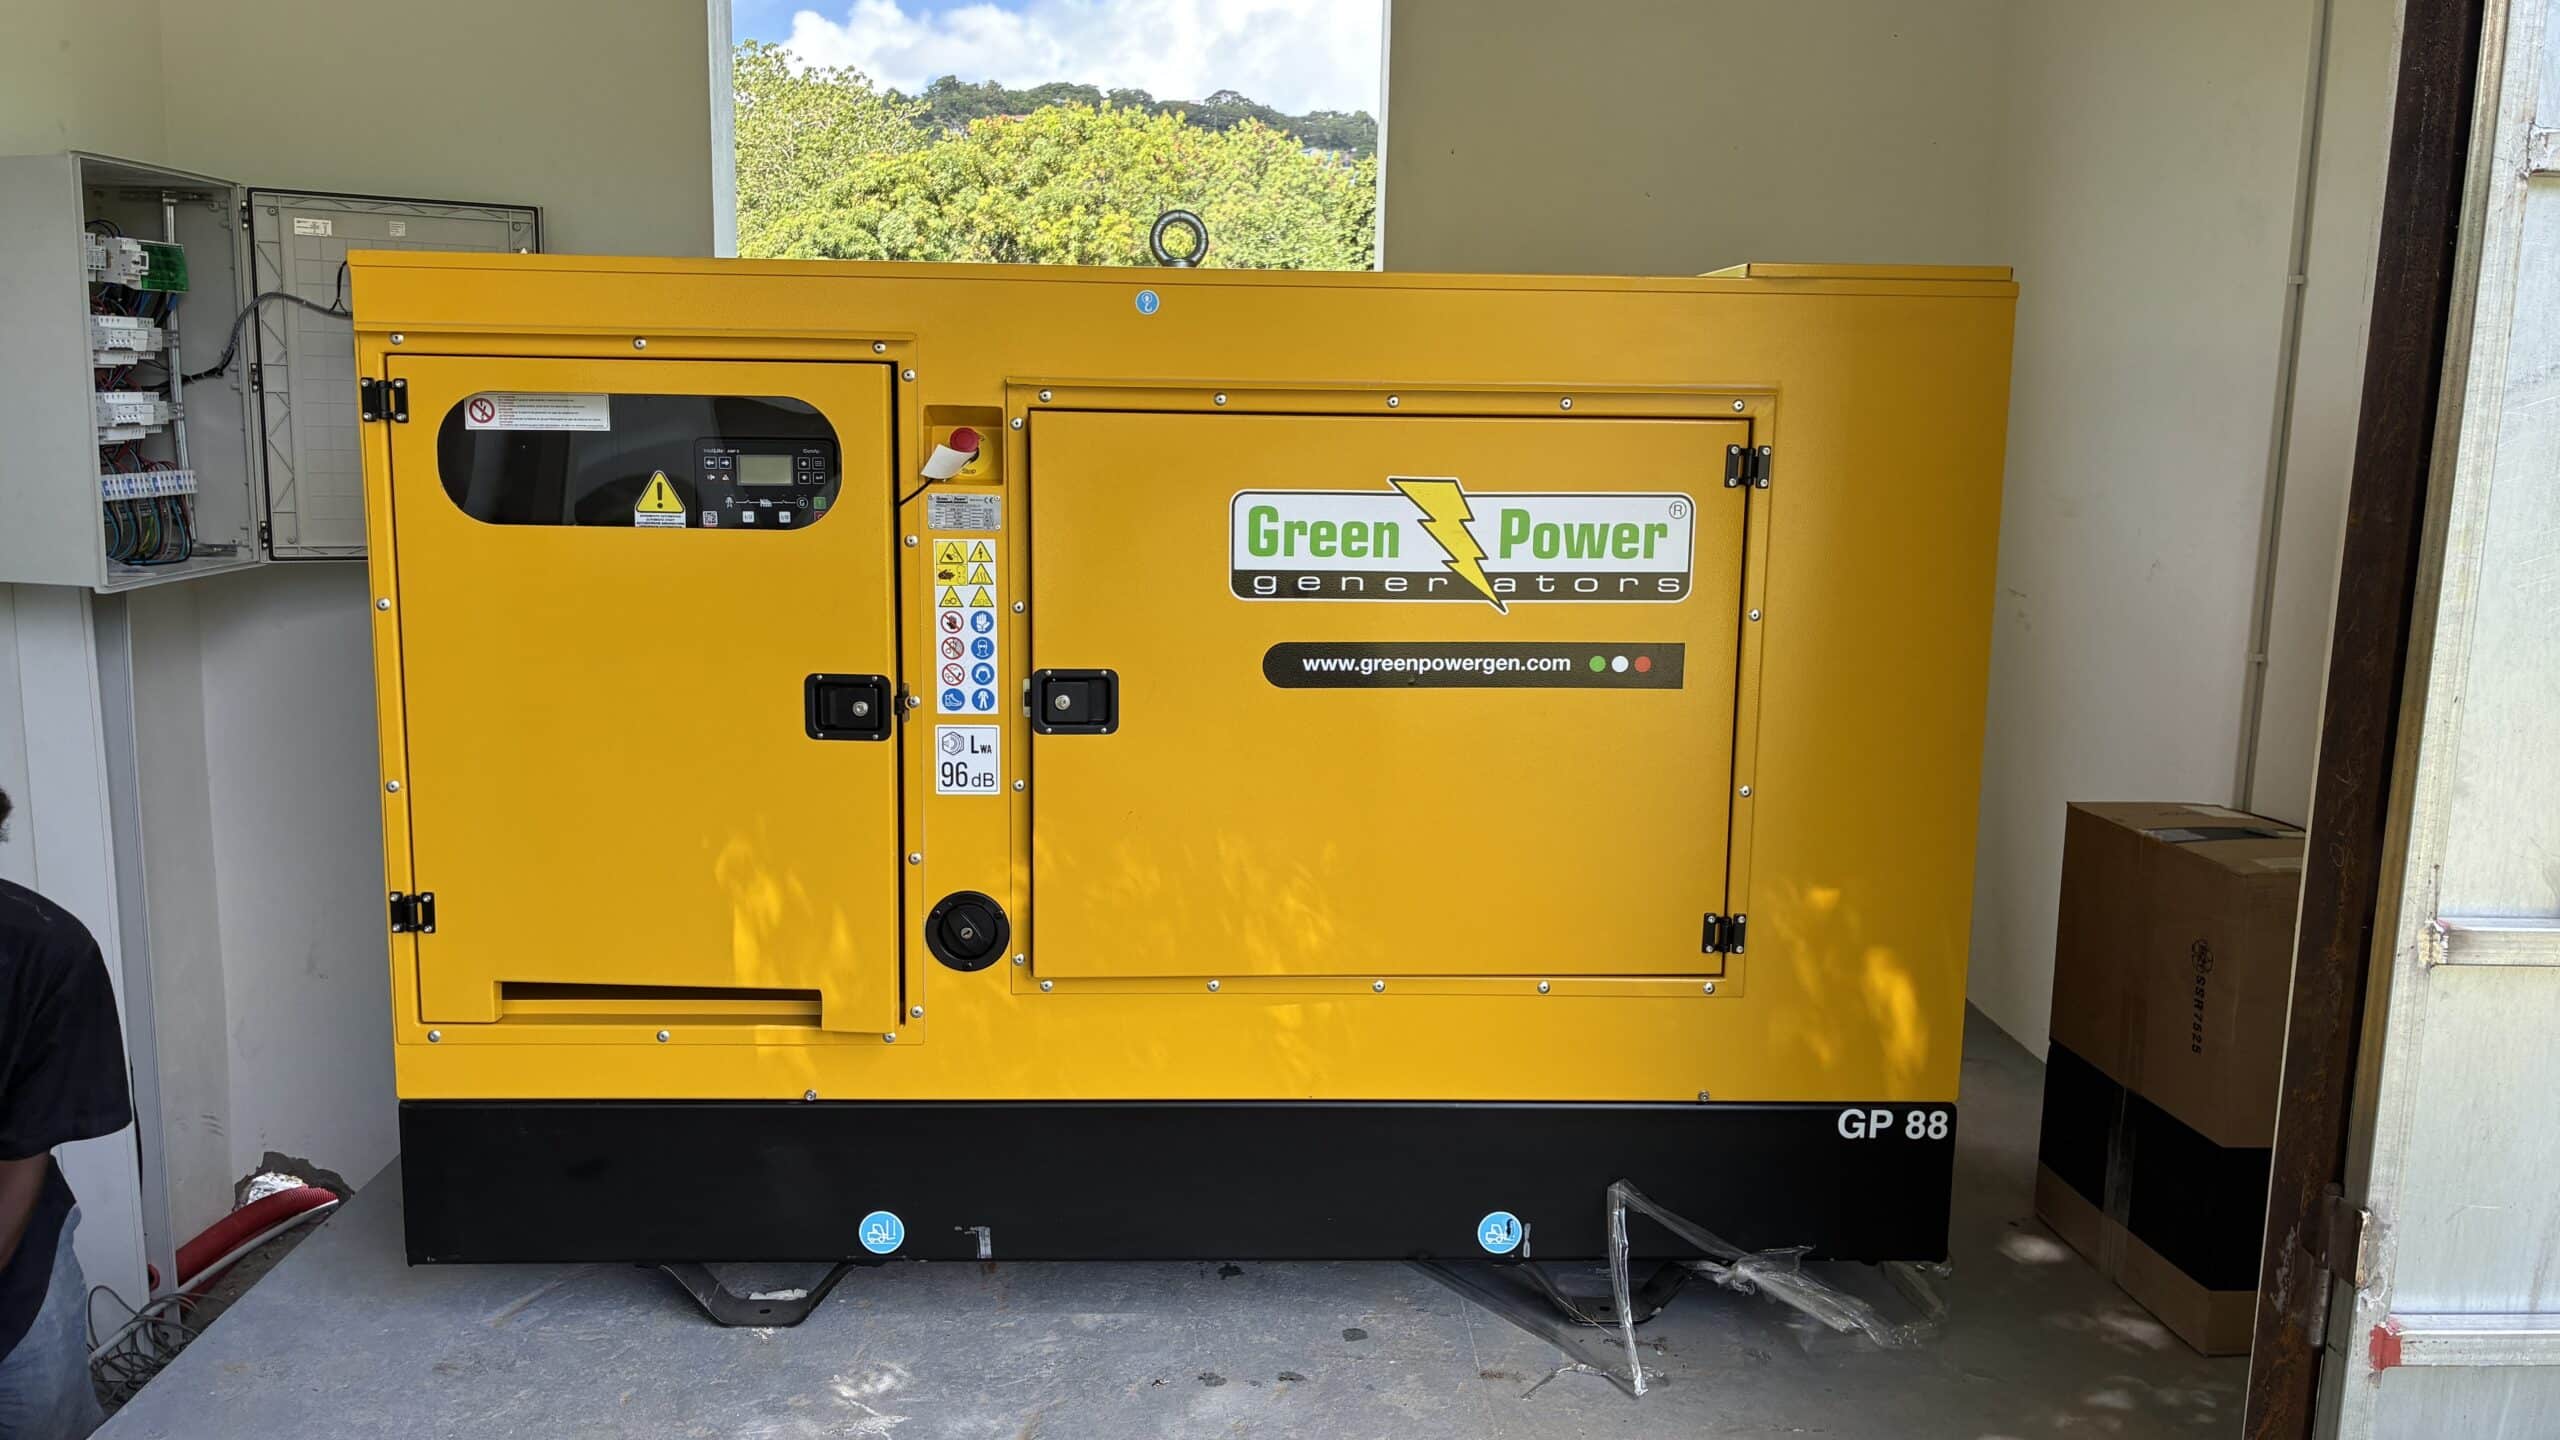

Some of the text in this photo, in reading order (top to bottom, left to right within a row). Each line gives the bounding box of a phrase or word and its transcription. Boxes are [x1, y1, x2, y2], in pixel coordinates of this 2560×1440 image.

[1248, 505, 1400, 558] Green
[1500, 508, 1668, 559] Power
[1253, 574, 1681, 595] generators
[1302, 657, 1571, 675] www.greenpowergen.com
[941, 761, 995, 788] 96 dB
[1837, 1108, 1949, 1140] GP 88
